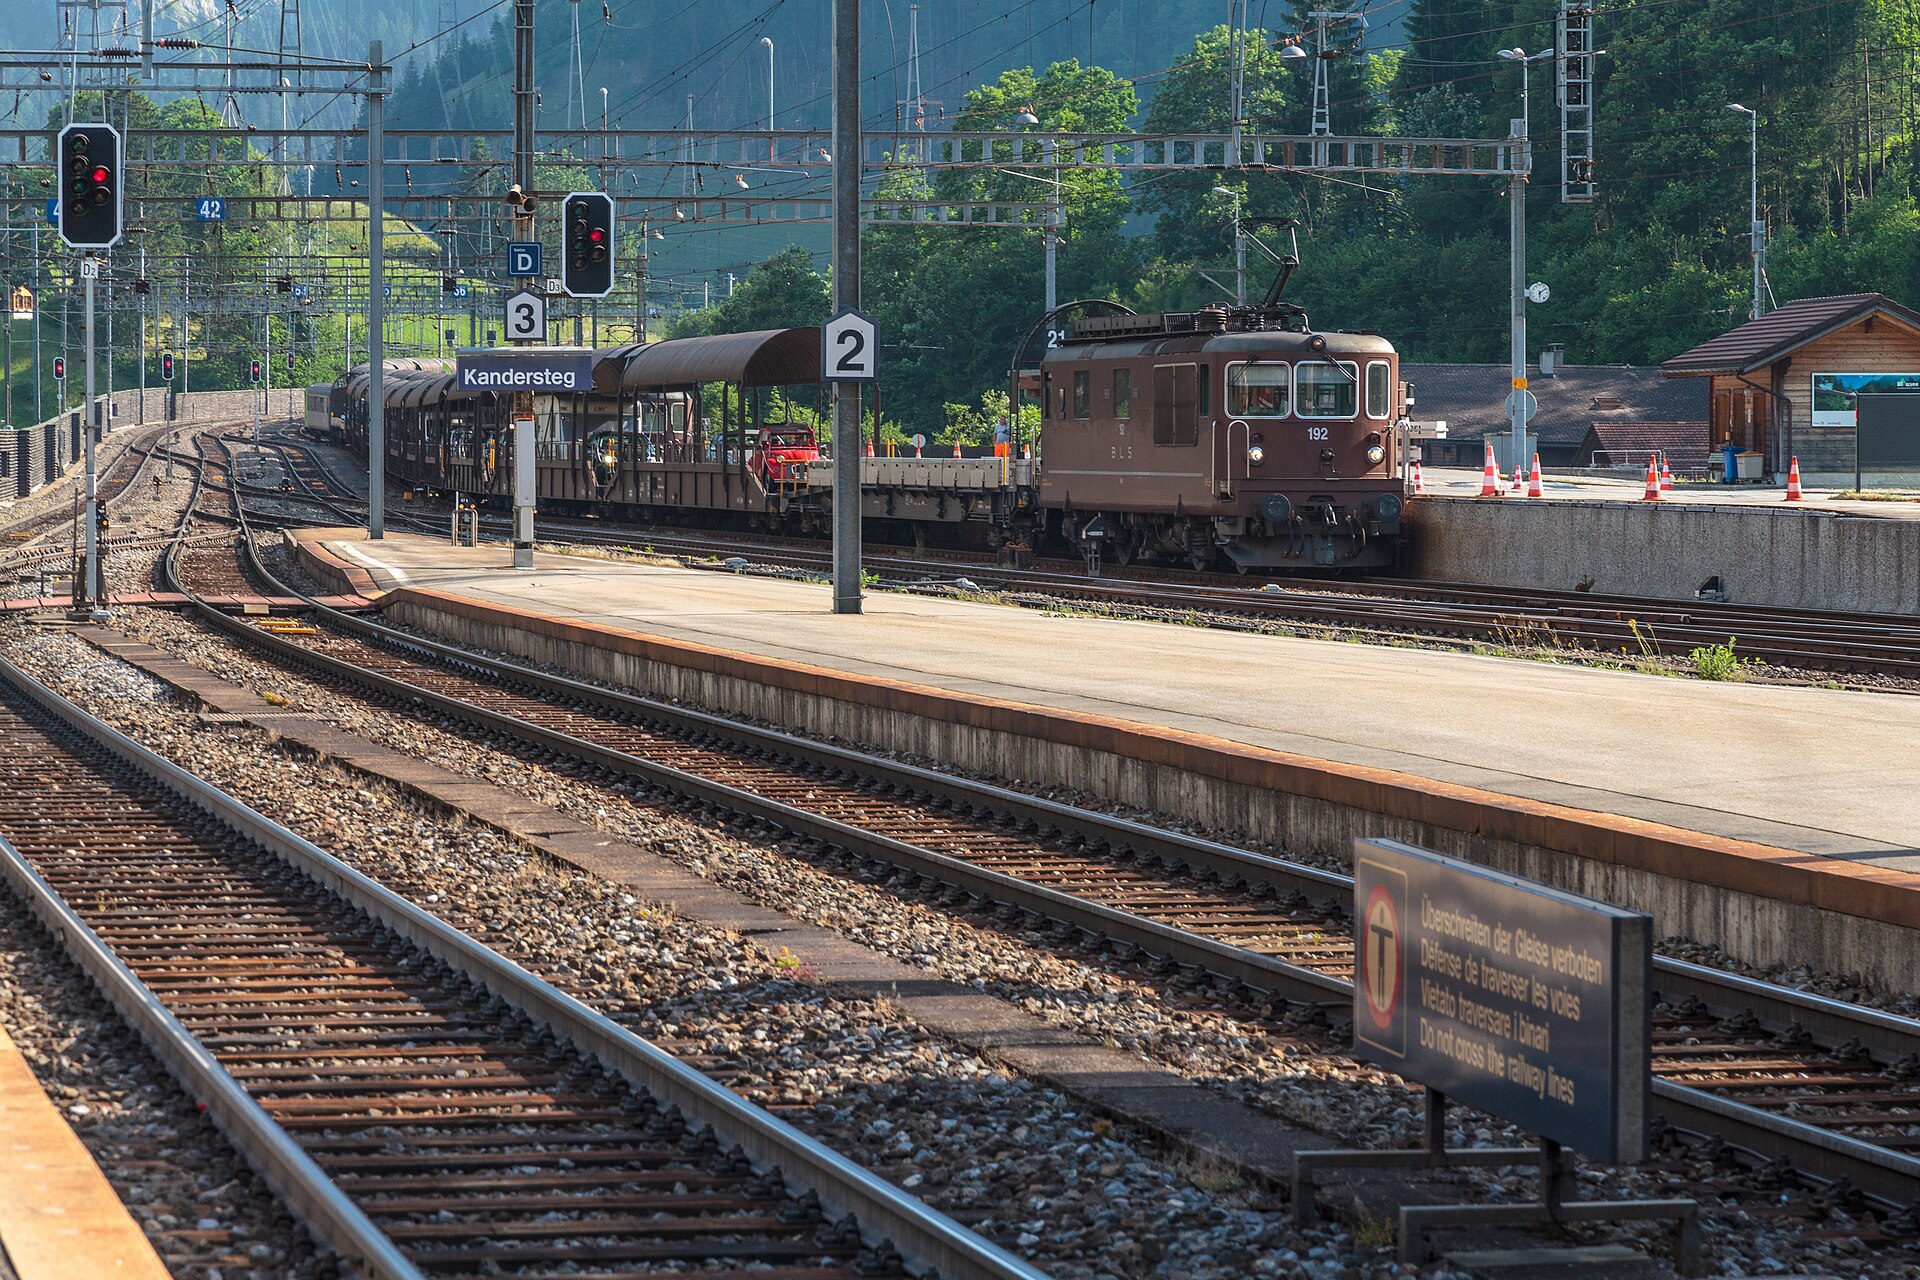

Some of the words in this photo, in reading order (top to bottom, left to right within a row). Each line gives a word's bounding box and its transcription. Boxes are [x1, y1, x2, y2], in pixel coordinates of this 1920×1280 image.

[200, 200, 220, 218] 42
[517, 253, 532, 271] D
[515, 303, 535, 334] 3
[836, 329, 865, 371] 2
[464, 368, 576, 388] Kandersteg
[1307, 427, 1329, 440] 192
[1421, 892, 1491, 949] Überschreiten
[1494, 922, 1512, 955] der
[1515, 928, 1549, 968] Gleise
[1550, 944, 1602, 986] verboten
[1420, 937, 1462, 980] Défense
[1464, 953, 1478, 985] de
[1481, 957, 1529, 1002] traverser
[1531, 974, 1548, 1011] les
[1550, 985, 1580, 1022] voies
[1420, 976, 1457, 1018] Vietato
[1458, 991, 1511, 1039] traversare
[1513, 1010, 1518, 1041] i
[1519, 1012, 1550, 1053] binari
[1420, 1017, 1434, 1050] Do
[1436, 1028, 1454, 1059] not
[1455, 1037, 1485, 1070] cross
[1487, 1042, 1505, 1078] the
[1507, 1053, 1546, 1100] railway
[1547, 1064, 1575, 1106] lines
